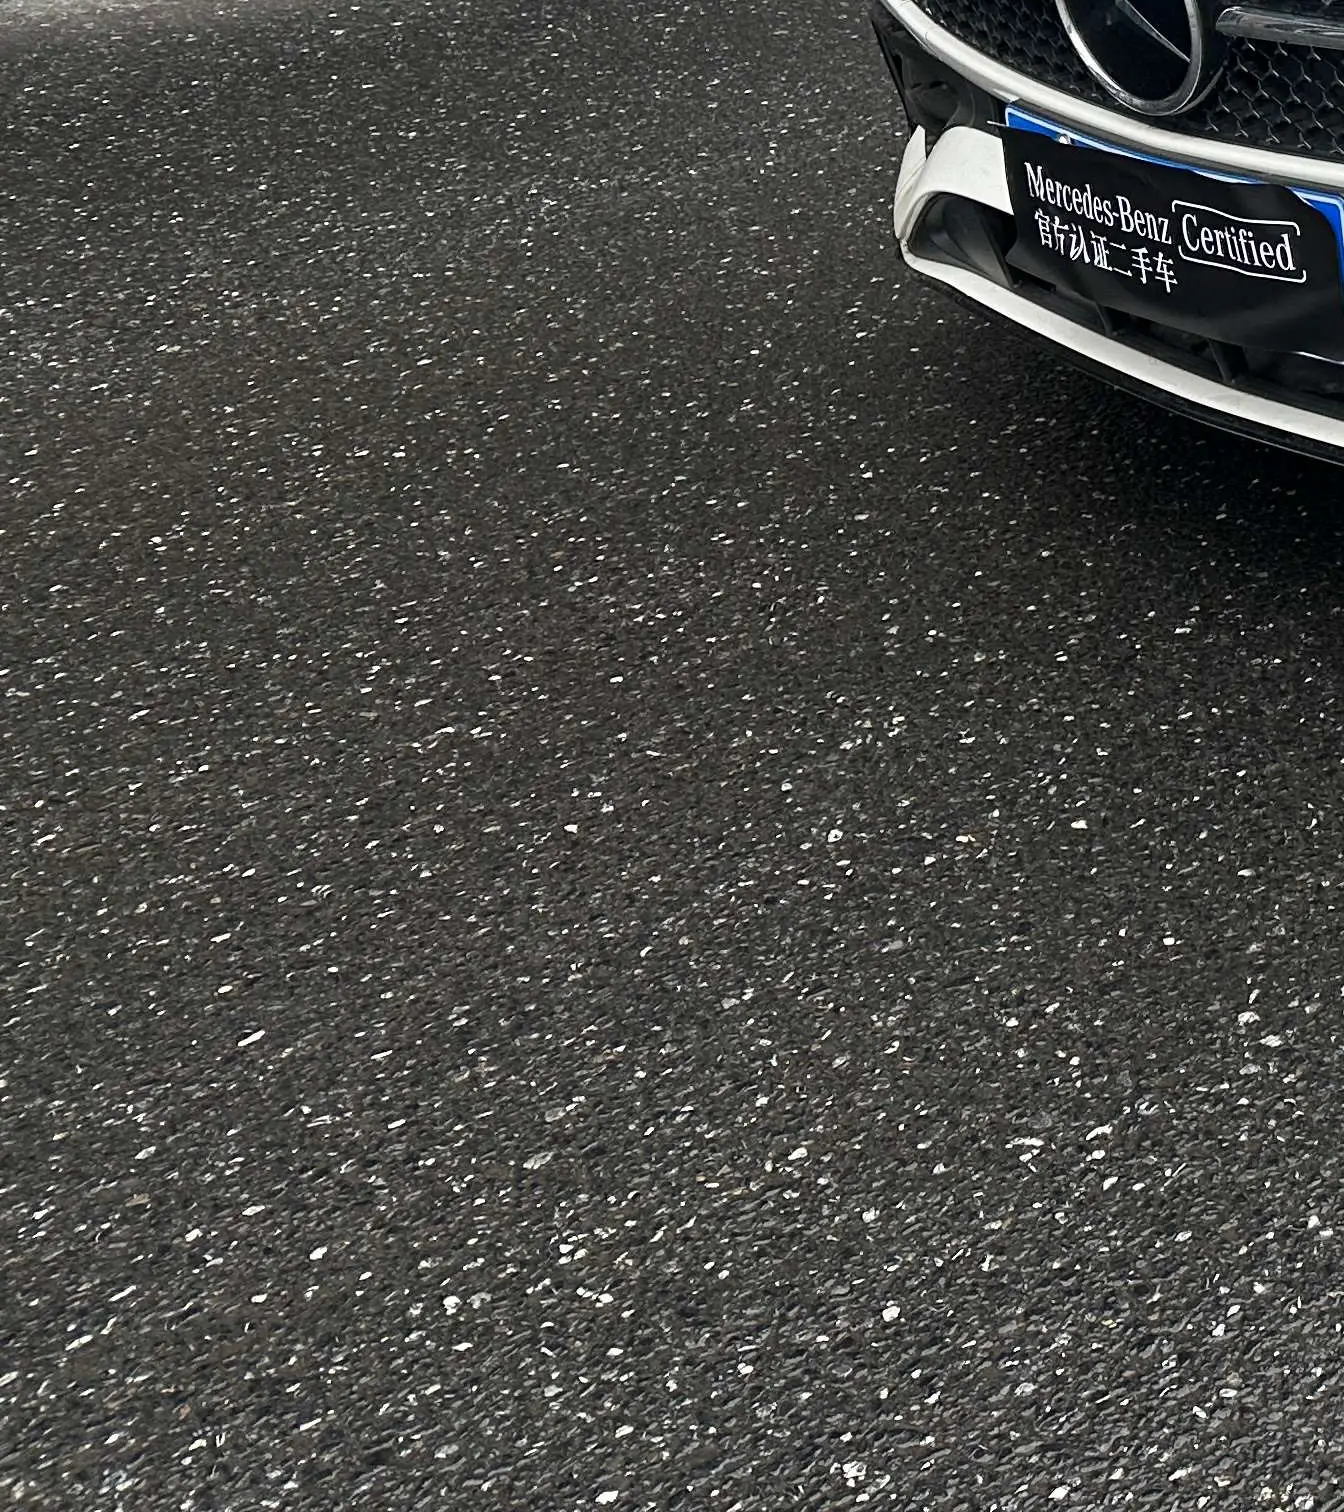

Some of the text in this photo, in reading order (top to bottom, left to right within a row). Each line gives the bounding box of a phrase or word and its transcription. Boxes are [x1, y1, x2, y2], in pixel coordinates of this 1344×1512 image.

[1024, 161, 1297, 271] Mercedes-Benz Certified
[1034, 208, 1178, 293] 官方认证二手车
